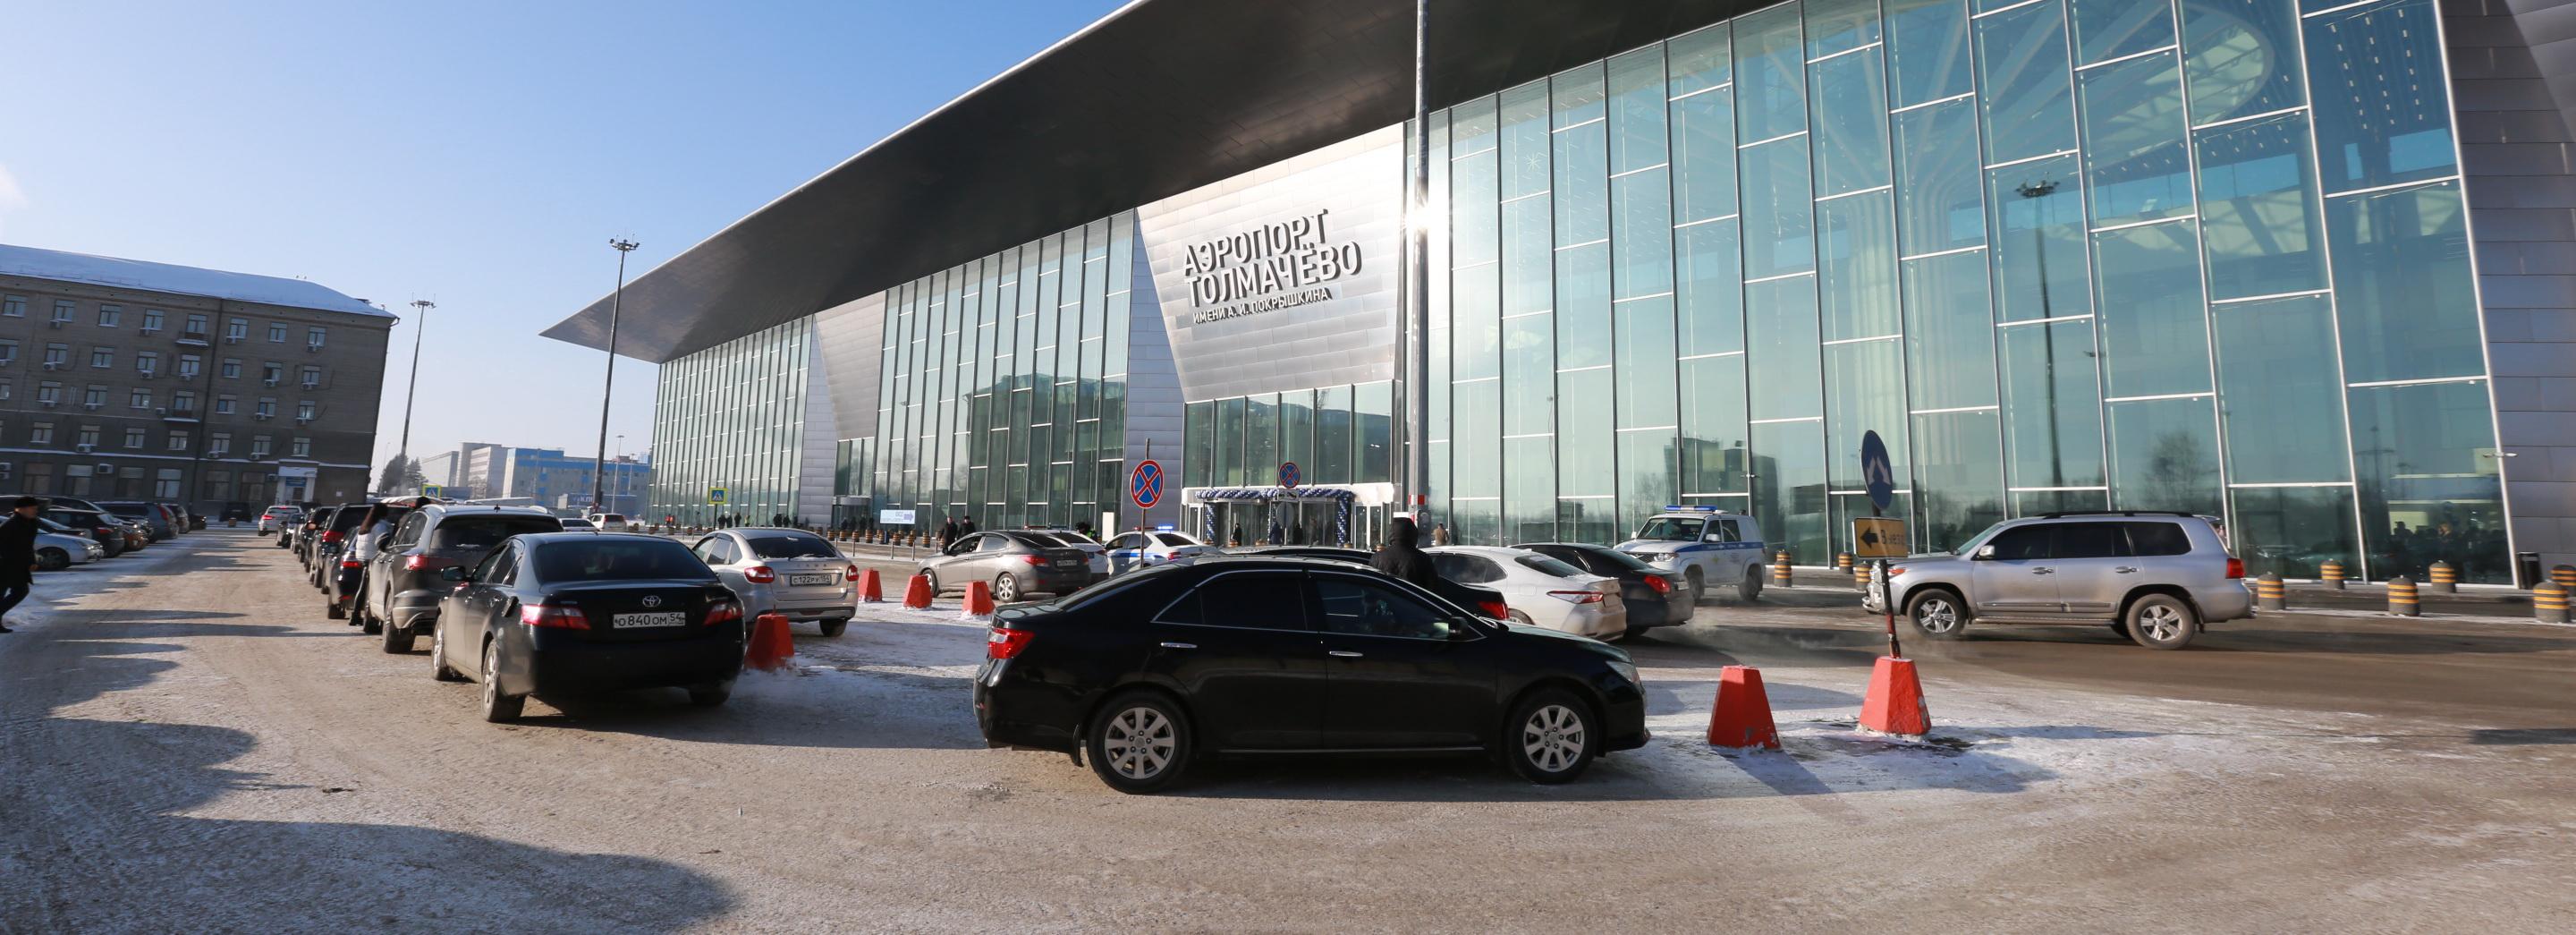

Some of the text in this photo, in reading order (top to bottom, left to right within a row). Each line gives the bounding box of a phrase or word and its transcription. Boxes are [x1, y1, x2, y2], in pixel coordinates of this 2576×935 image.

[1182, 208, 1328, 276] АЭРОПОРТ
[1183, 241, 1362, 308] ТОЛМАЧЁВО
[1192, 307, 1228, 324] ИМЕНИ
[1251, 287, 1332, 314] ПОКРЫШКИНА
